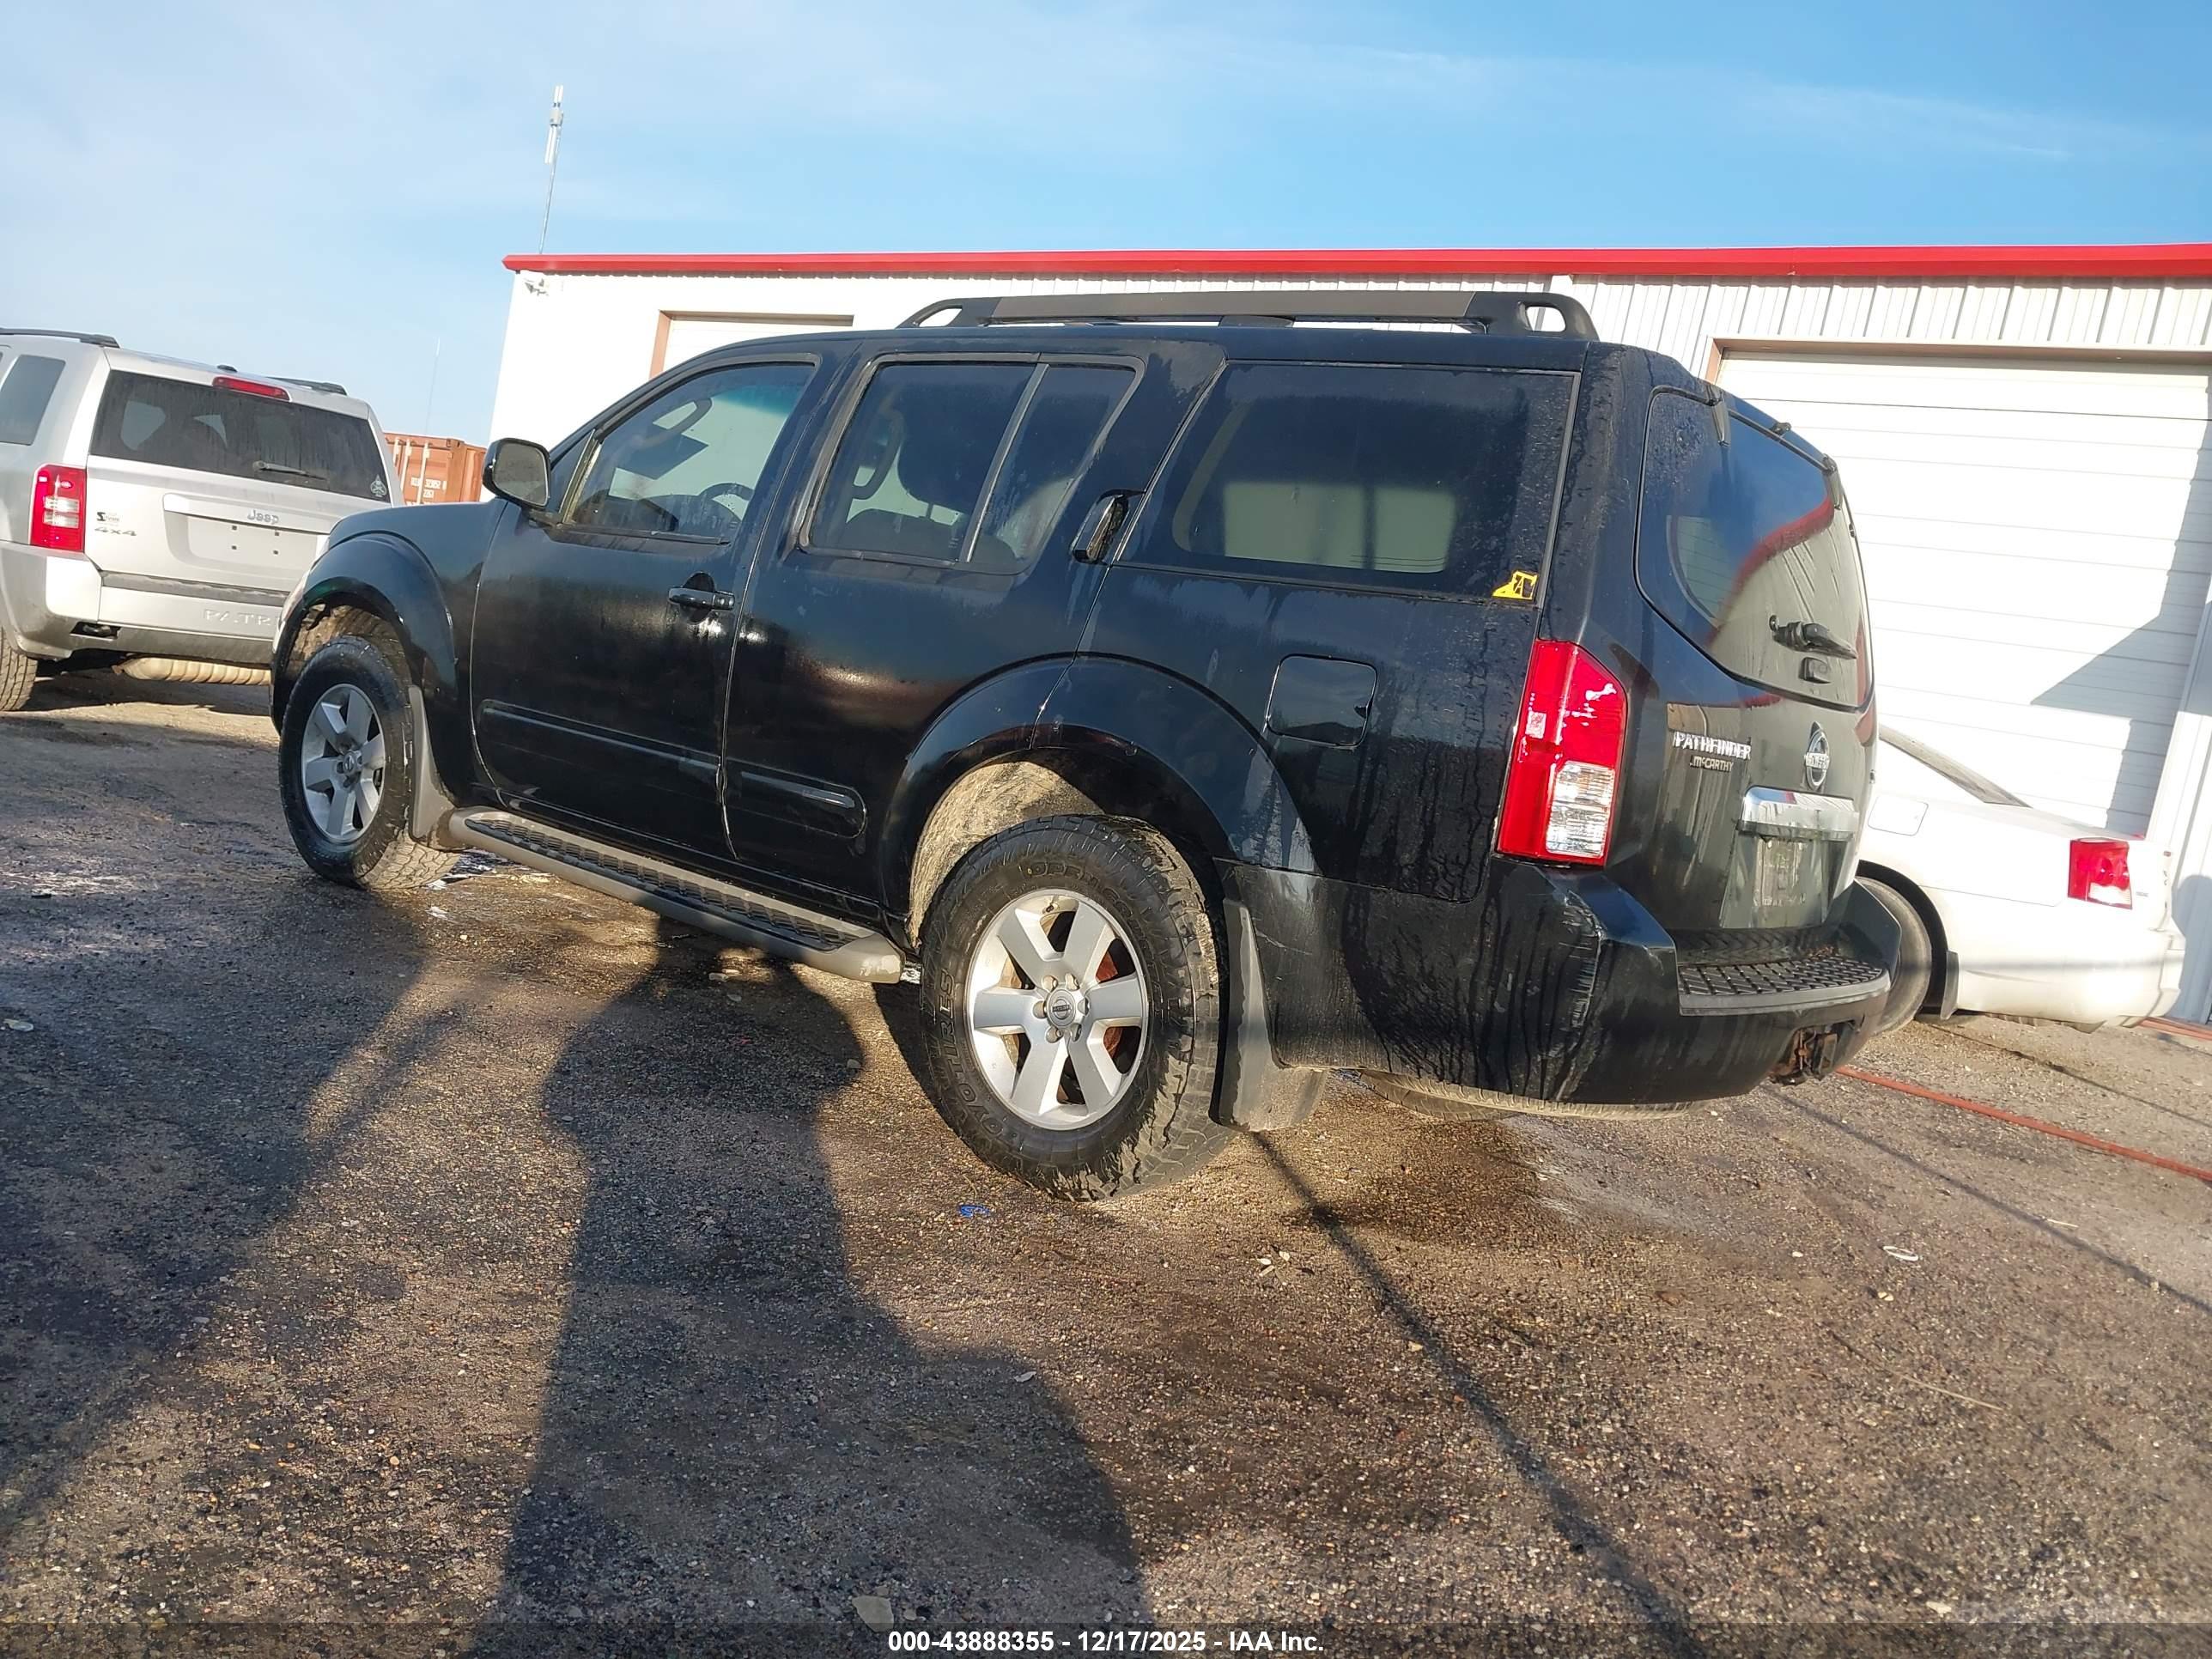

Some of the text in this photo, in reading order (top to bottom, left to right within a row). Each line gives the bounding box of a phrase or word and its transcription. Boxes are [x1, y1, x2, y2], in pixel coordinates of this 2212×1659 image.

[246, 509, 279, 525] Jeep
[1673, 731, 1752, 761] PATHFINDER
[937, 969, 964, 1079] TIRES
